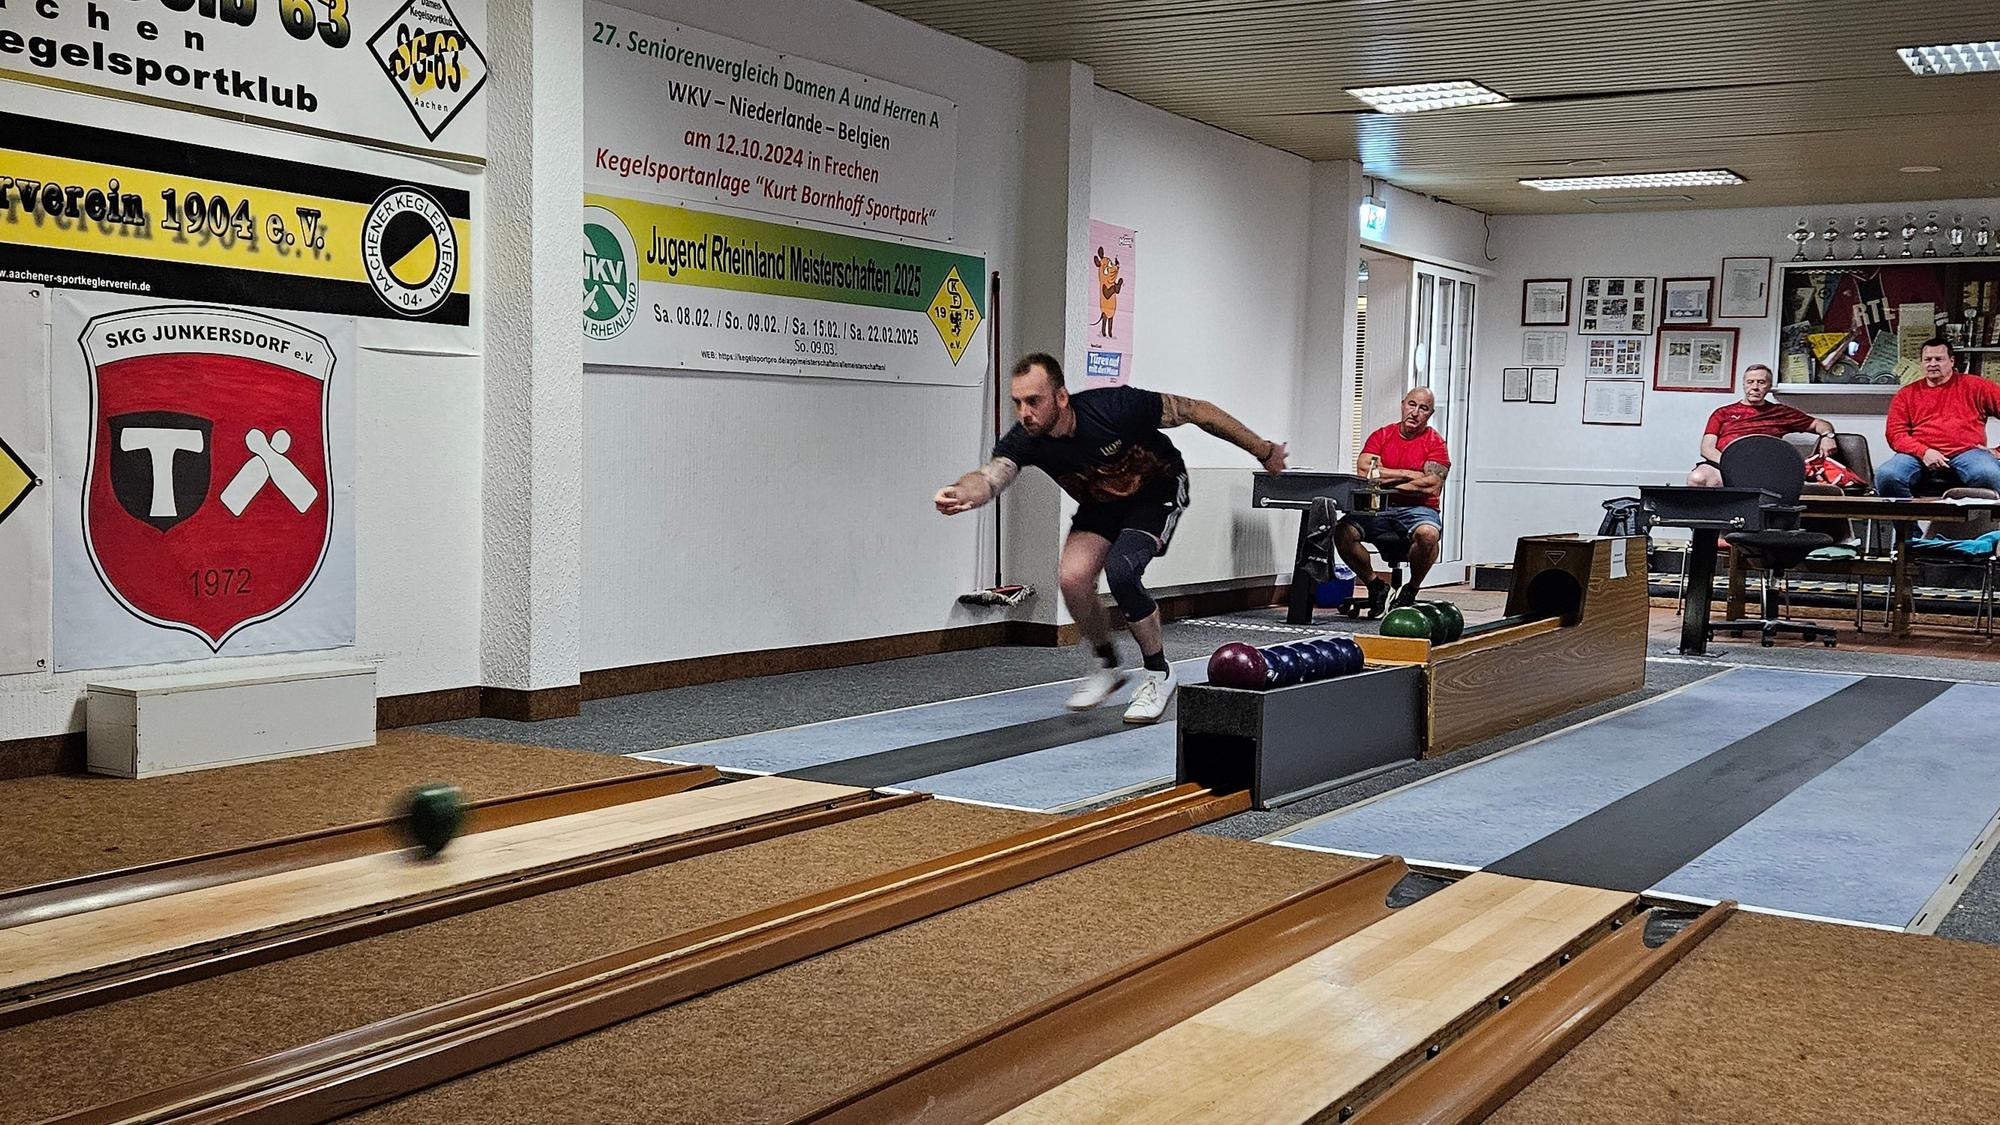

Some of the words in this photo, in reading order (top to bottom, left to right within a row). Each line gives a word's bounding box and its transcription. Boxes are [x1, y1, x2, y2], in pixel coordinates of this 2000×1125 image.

[592, 21, 620, 48] 27.
[627, 31, 778, 88] Seniorenvergleich
[784, 72, 835, 102] Damen
[839, 87, 850, 106] A
[854, 95, 882, 114] und
[883, 98, 926, 126] Herren
[929, 111, 939, 129] A
[414, 97, 448, 112] Aachen
[668, 80, 711, 108] WKV
[729, 95, 822, 134] Niederlande
[838, 122, 890, 150] Belgien
[596, 147, 750, 196] Kegelsportanlage
[801, 185, 865, 217] Bornhoff
[684, 129, 711, 149] am
[716, 133, 803, 168] 12.10.2024
[807, 151, 820, 171] in
[825, 155, 879, 183] Frechen
[161, 188, 253, 240] 1904
[266, 207, 325, 249] e.V.
[368, 201, 395, 293] AACHENER
[395, 195, 447, 235] KEGLER
[430, 238, 452, 299] VEREIN
[647, 225, 707, 277] Jugend
[711, 235, 785, 281] Rheinland
[790, 246, 891, 294] Meisterschaften
[893, 263, 921, 298] 2025
[591, 282, 637, 336] RHEINLAND
[653, 303, 673, 324] Sa.
[677, 306, 712, 328] 08.02.
[725, 310, 743, 330] So.
[747, 313, 780, 334] 09.02.
[792, 317, 809, 335] Sa.
[813, 319, 840, 339] 15.02.
[850, 323, 865, 341] Sa.
[868, 325, 919, 346] 22.02.2025
[1853, 296, 1896, 328] RTL
[106, 328, 146, 349] SKG
[152, 325, 291, 354] JUNKERSDORF
[294, 349, 313, 364] e.V.
[794, 339, 809, 353] So.
[810, 340, 837, 356] 09.03.
[190, 568, 251, 595] 1972
